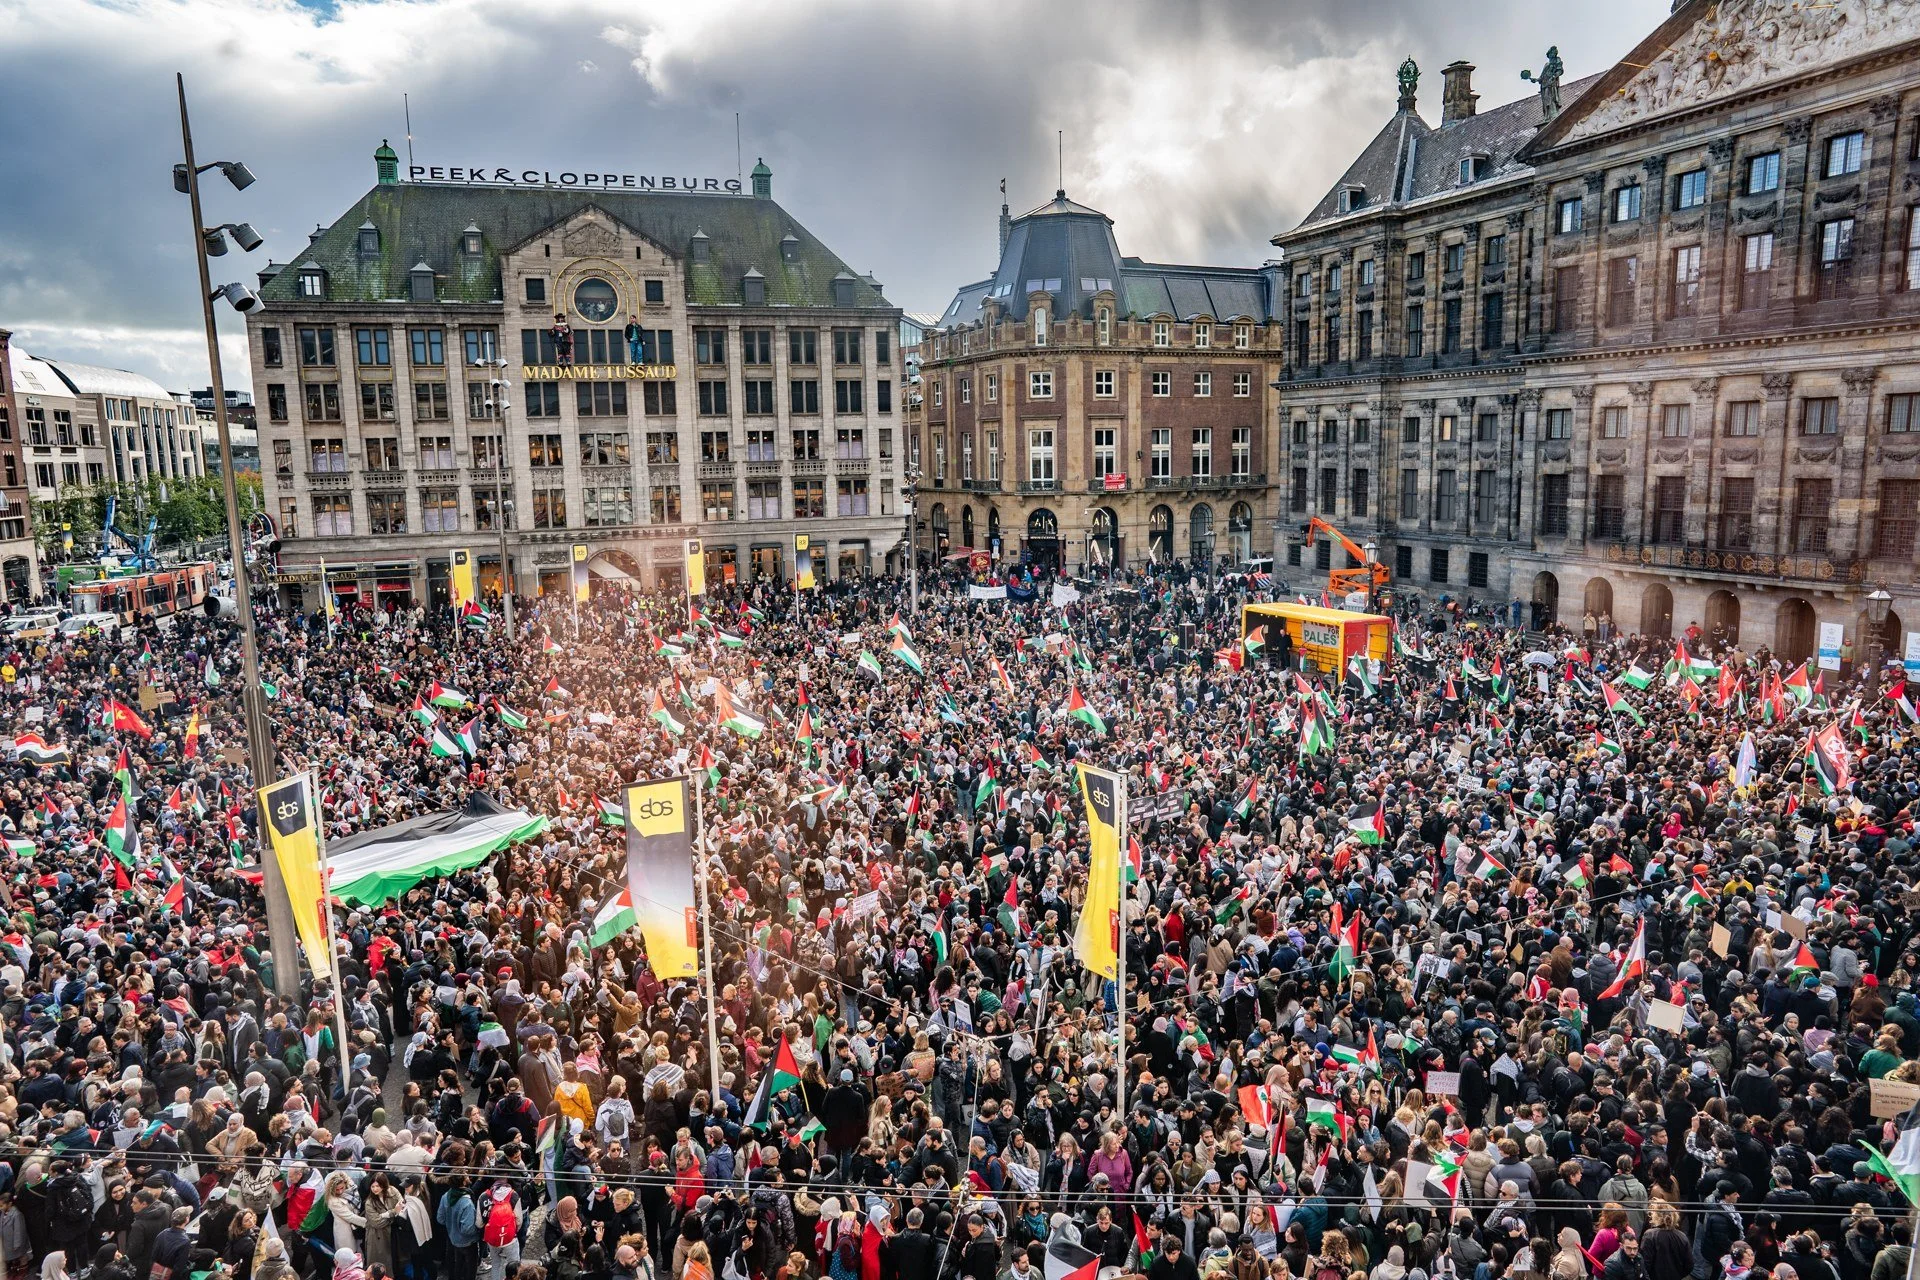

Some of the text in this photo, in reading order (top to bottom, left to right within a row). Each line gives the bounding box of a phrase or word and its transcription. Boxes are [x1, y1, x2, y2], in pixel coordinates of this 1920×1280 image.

[409, 166, 486, 181] PEEK
[522, 171, 742, 190] CLOPPENBURG
[522, 365, 677, 379] MADAME TUSSAUD
[276, 573, 315, 582] MADAME
[1304, 630, 1338, 645] PALES
